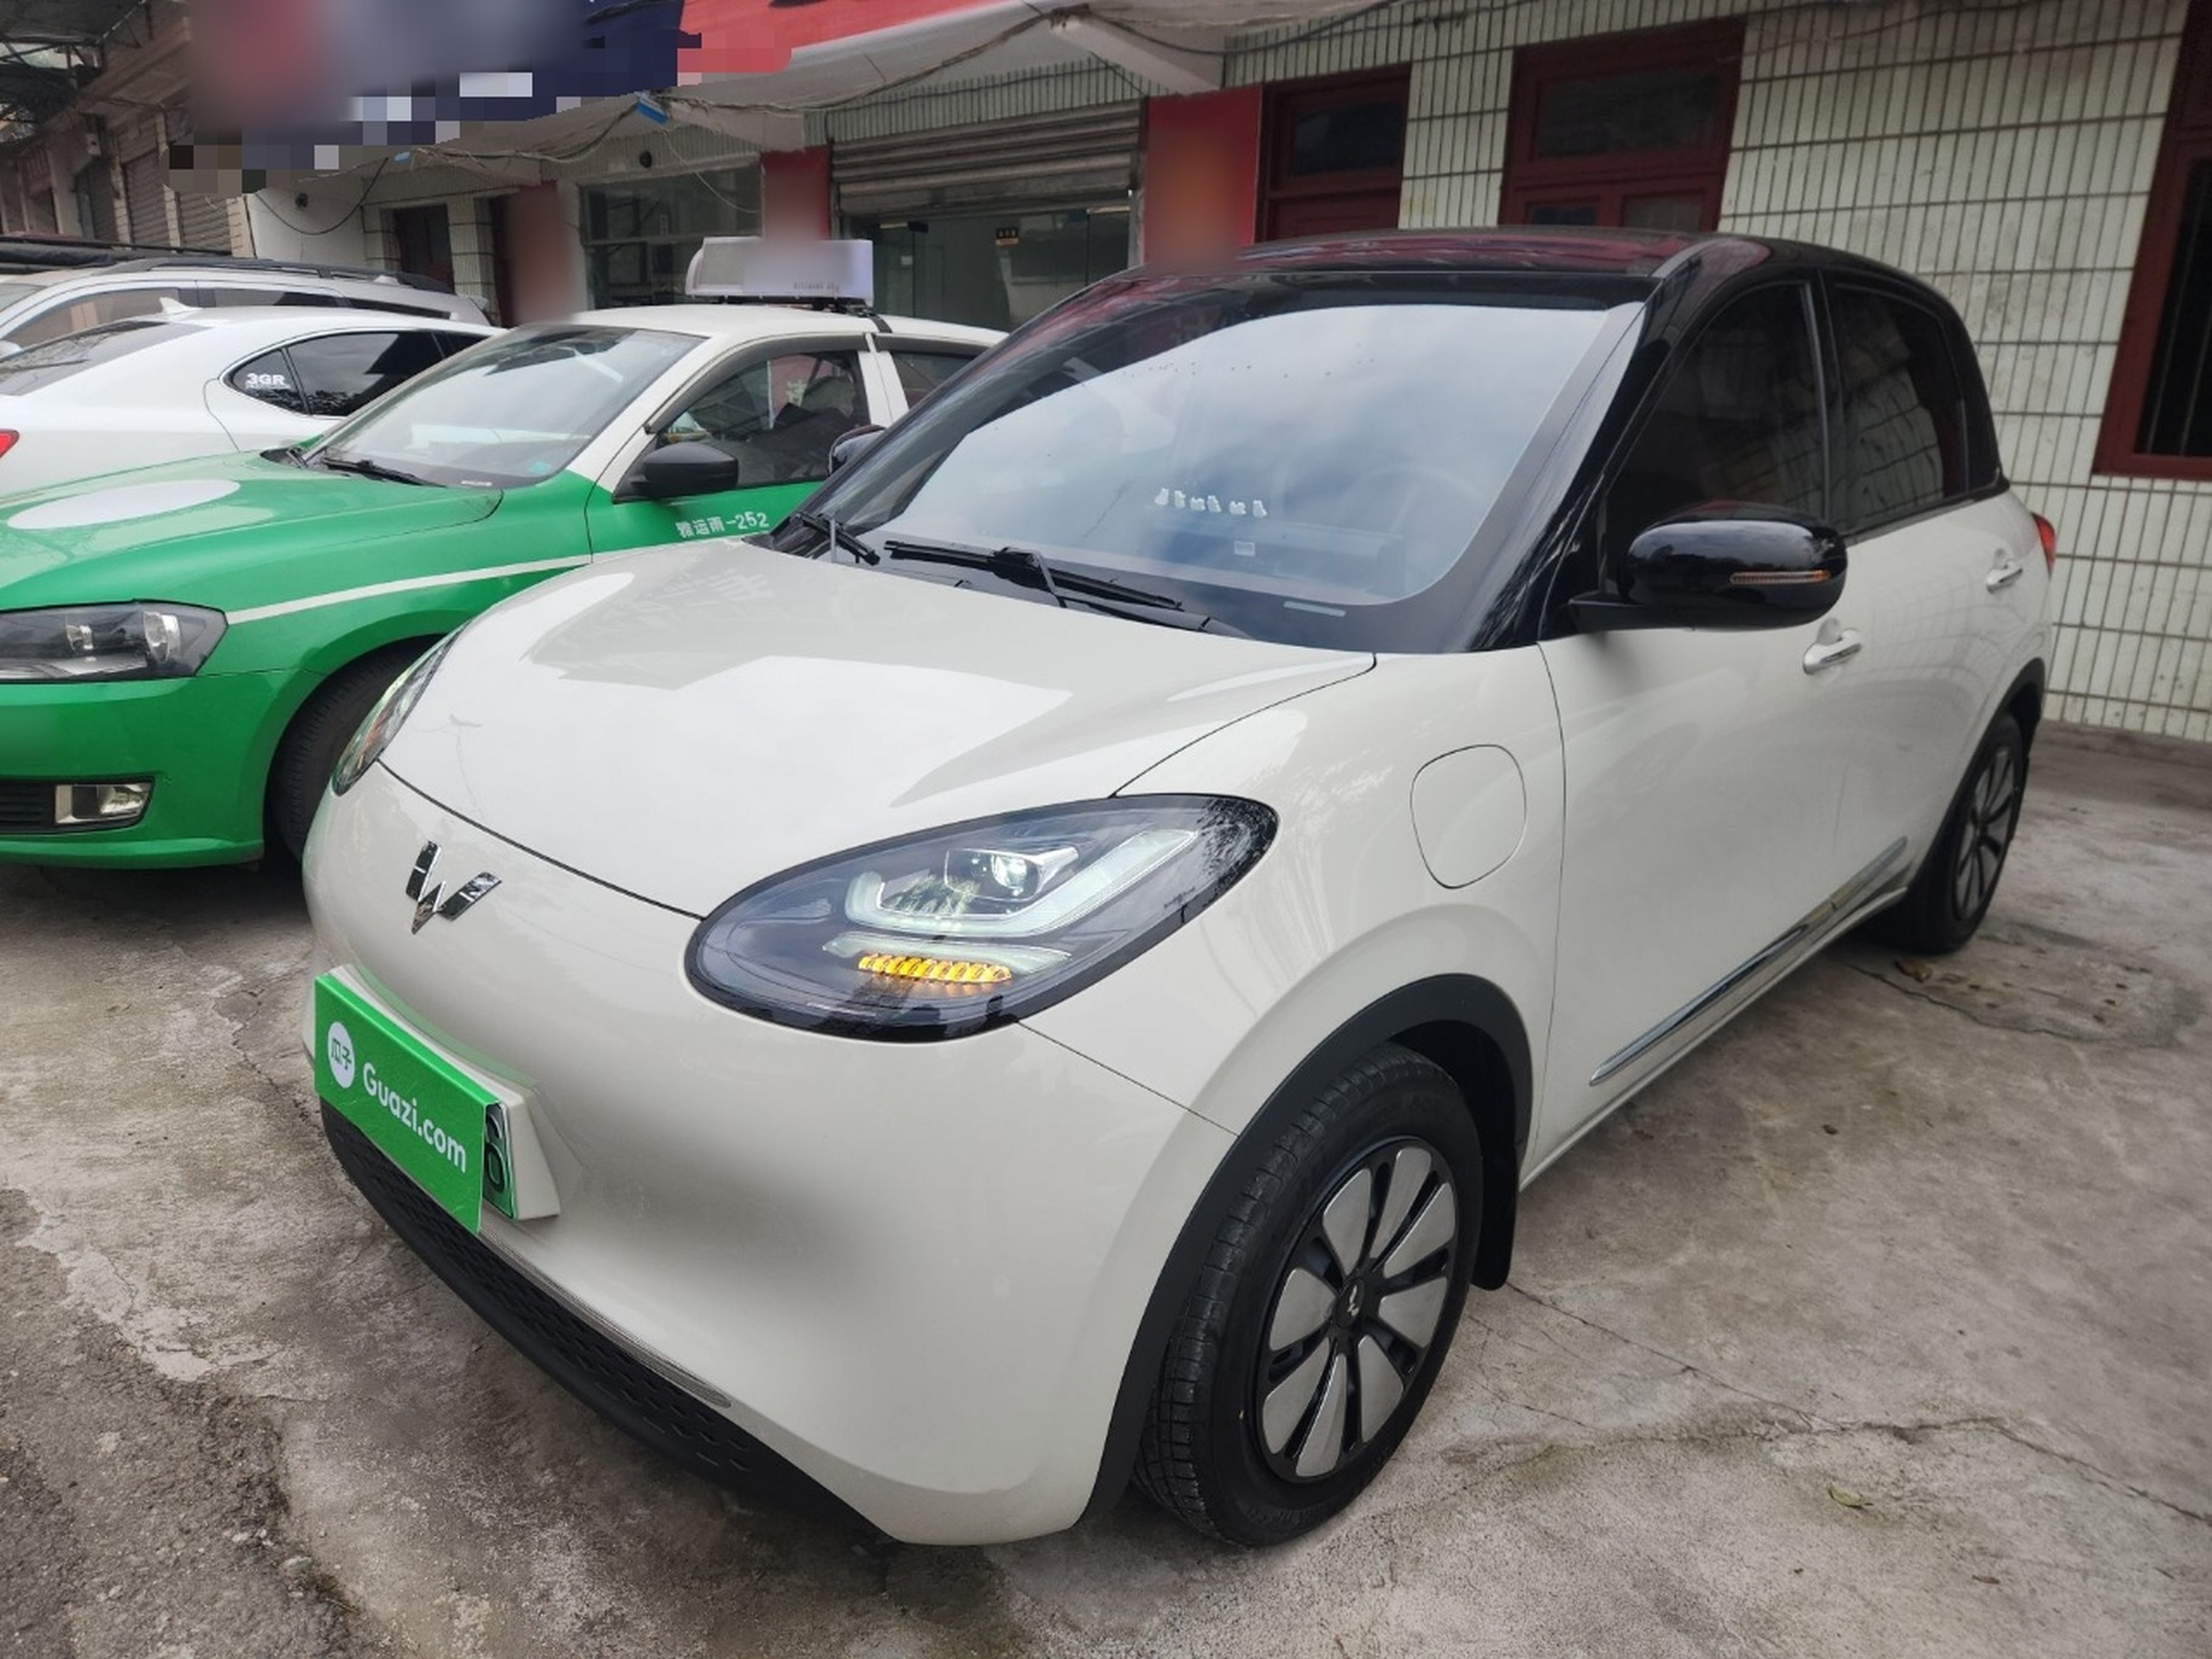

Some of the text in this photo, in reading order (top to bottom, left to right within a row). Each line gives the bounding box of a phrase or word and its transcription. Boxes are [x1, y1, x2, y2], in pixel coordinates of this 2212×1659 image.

[245, 373, 285, 385] 3GR
[331, 1037, 353, 1070] 瓜子
[363, 1062, 467, 1173] Guazi.com
